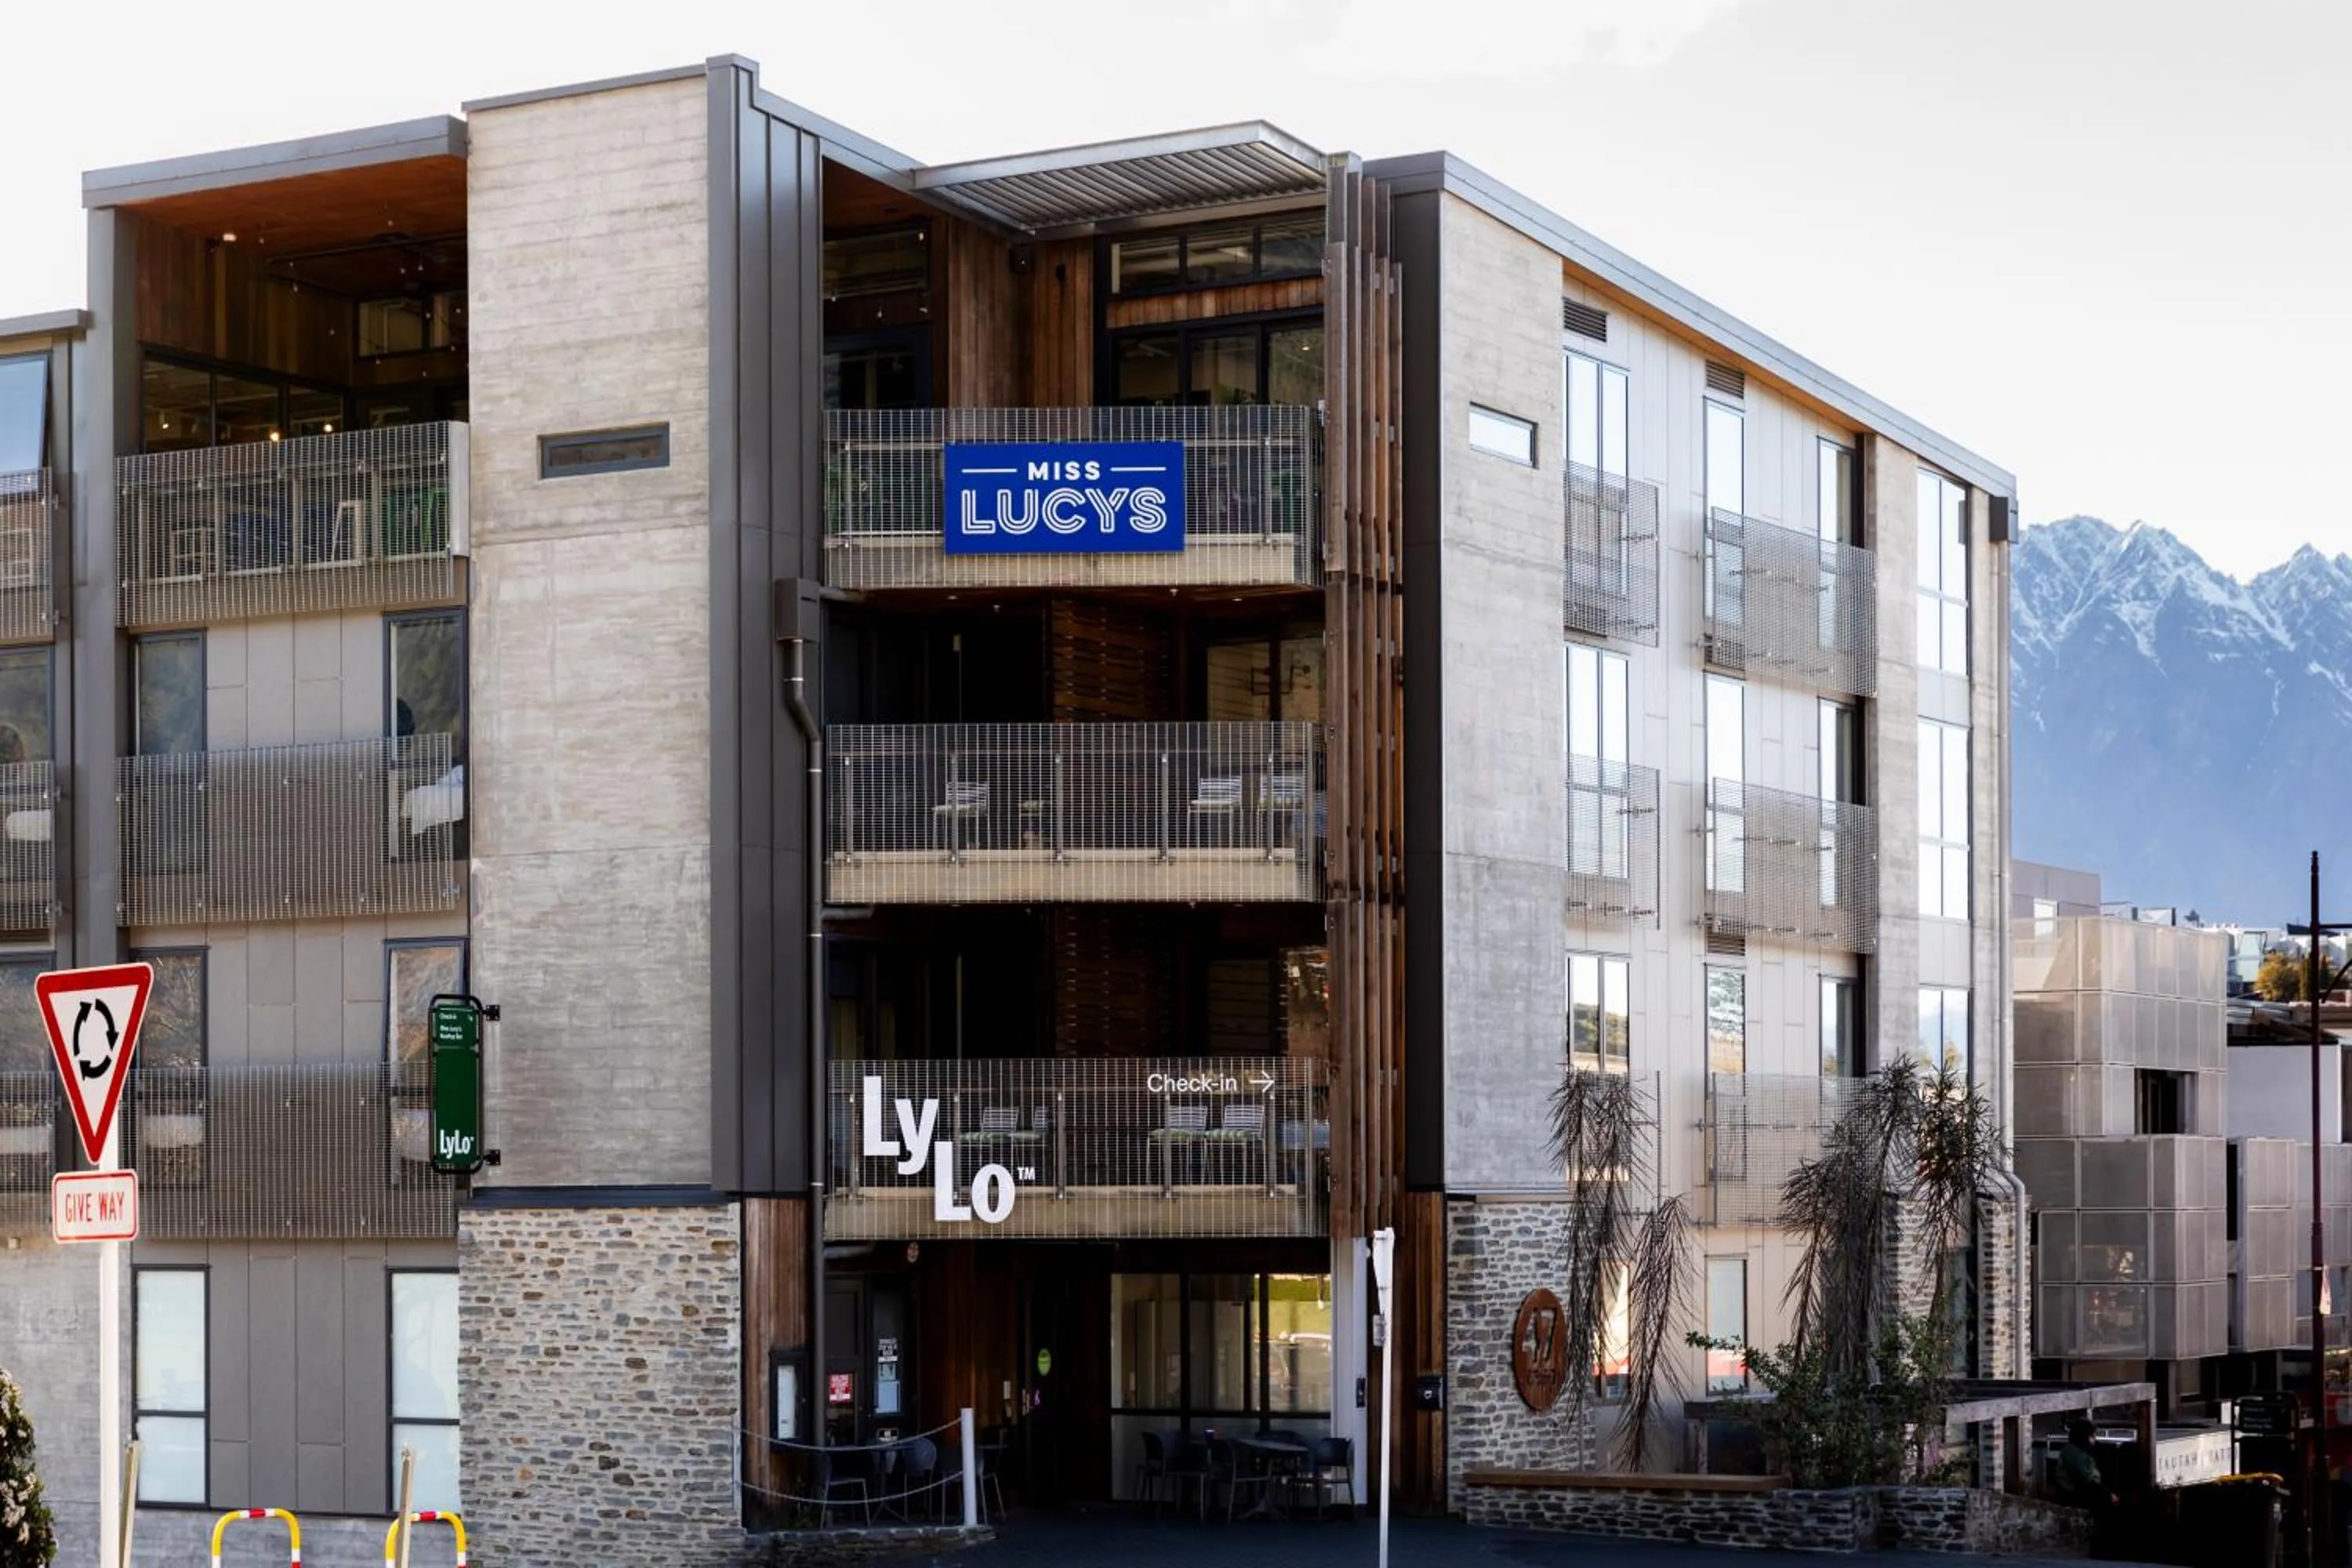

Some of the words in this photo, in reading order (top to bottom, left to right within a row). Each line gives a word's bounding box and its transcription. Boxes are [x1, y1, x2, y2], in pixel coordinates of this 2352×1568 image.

[1028, 461, 1101, 481] MISS
[961, 487, 1167, 534] LUCYS
[1147, 1073, 1237, 1092] Check-in
[440, 1129, 470, 1160] LyLo
[65, 1192, 93, 1223] GIVE
[99, 1191, 125, 1221] WAY
